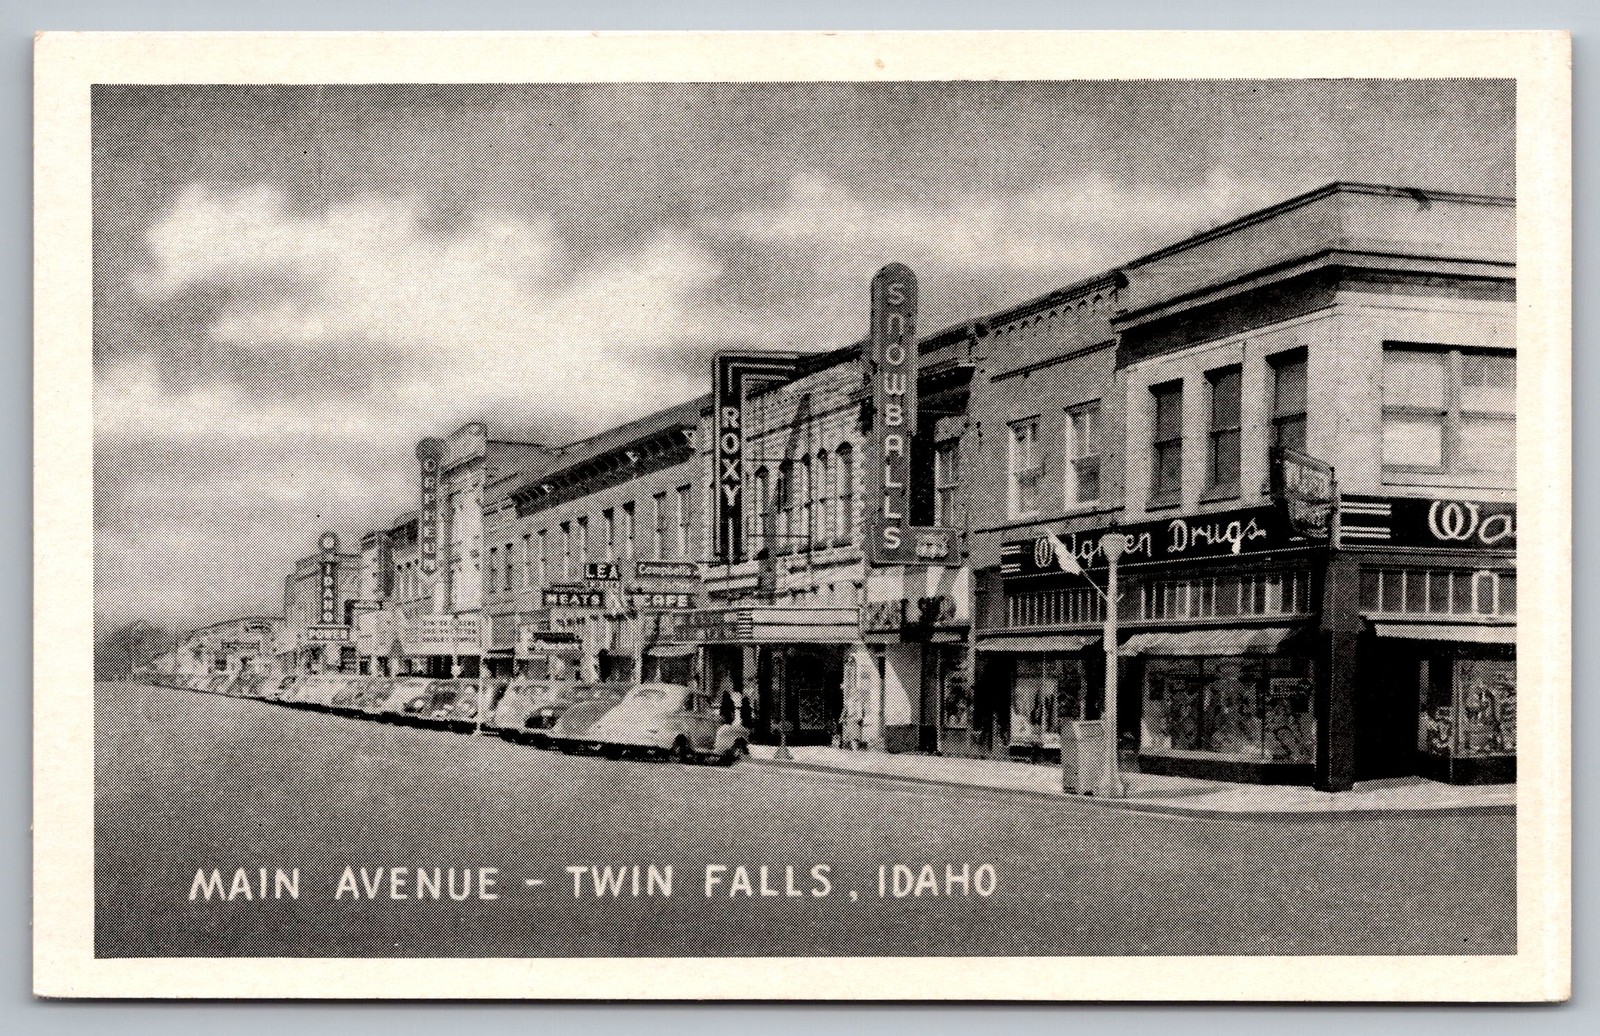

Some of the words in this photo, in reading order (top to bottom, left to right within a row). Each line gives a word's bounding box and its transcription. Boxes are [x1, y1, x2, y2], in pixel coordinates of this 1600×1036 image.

[883, 283, 907, 550] SNOWBALLS
[720, 405, 741, 508] ROXY
[1034, 532, 1152, 569] Wlgen
[1166, 517, 1267, 555] Drugs
[585, 564, 619, 579] LEA
[323, 563, 334, 622] IDAHO
[545, 594, 601, 606] MEATS
[642, 594, 689, 608] CAFE
[308, 628, 348, 640] POWER
